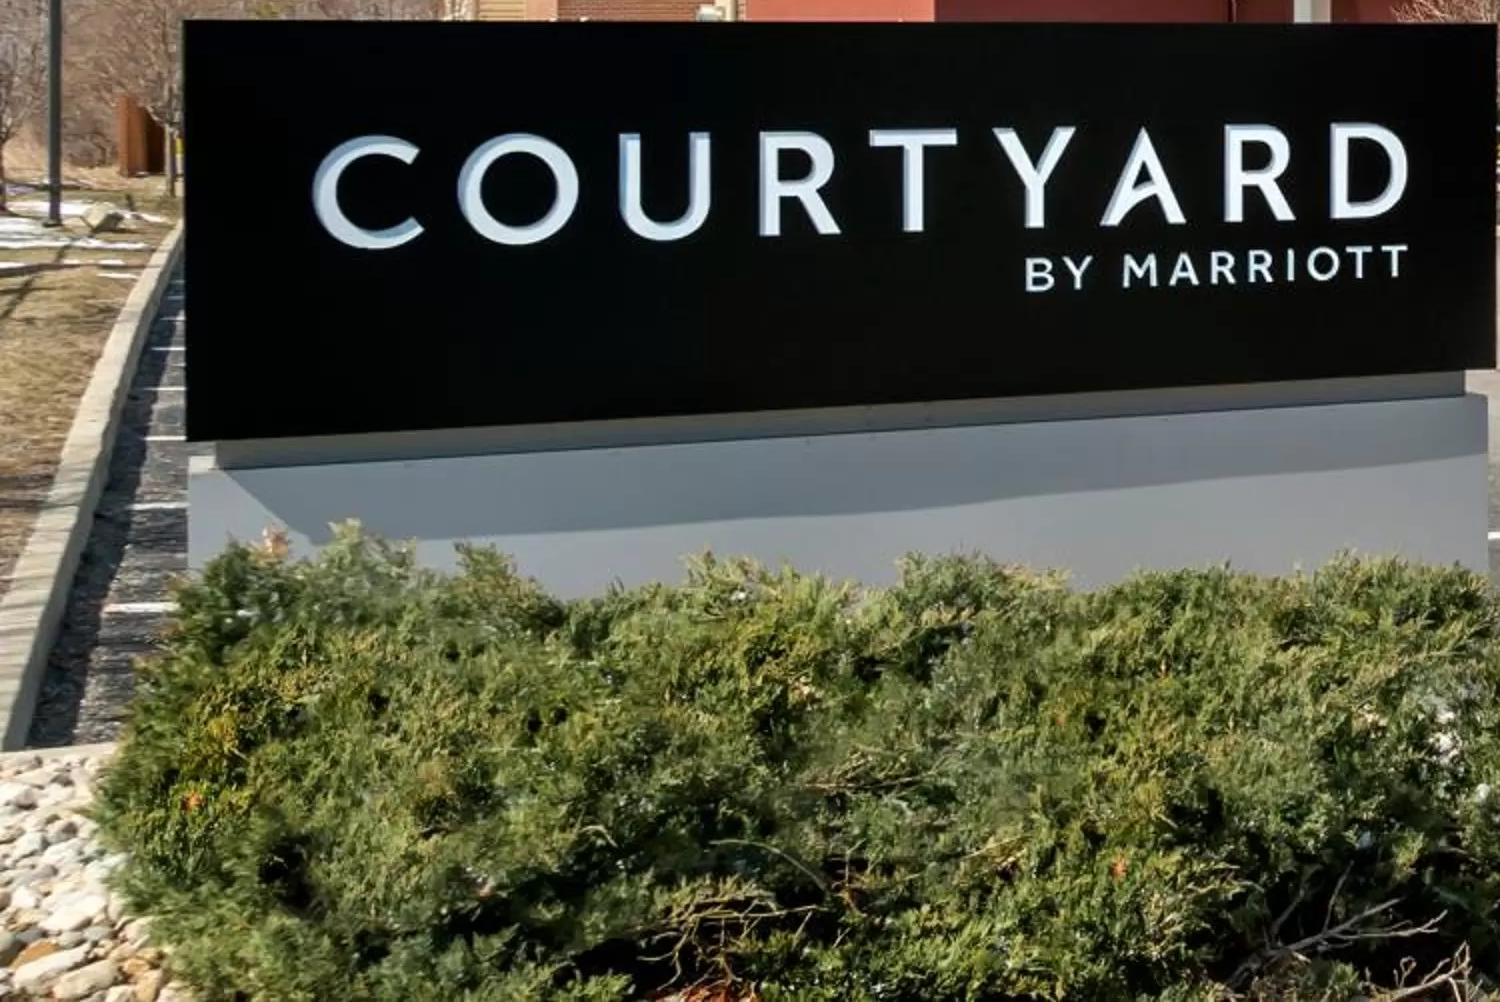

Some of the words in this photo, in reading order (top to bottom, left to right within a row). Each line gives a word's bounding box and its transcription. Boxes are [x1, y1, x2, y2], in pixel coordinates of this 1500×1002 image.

[312, 122, 1409, 250] COURTYARD
[1024, 255, 1093, 292] BY
[1122, 244, 1409, 288] MARRIOTT
